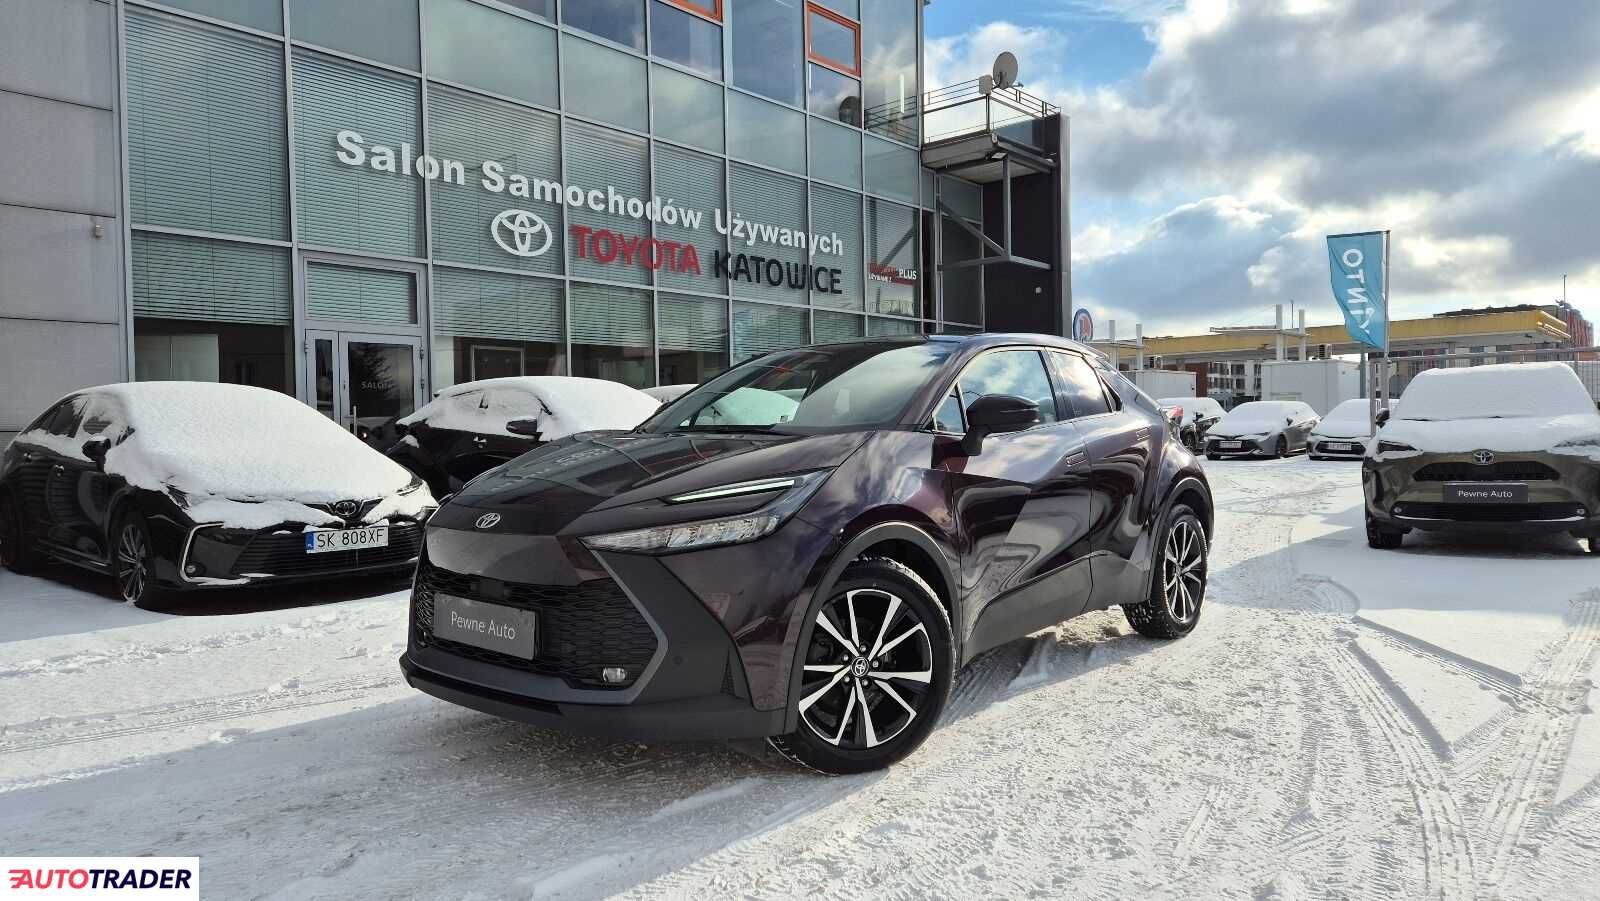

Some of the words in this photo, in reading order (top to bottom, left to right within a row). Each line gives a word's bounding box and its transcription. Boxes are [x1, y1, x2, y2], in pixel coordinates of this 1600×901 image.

[336, 130, 465, 186] Salon
[481, 160, 703, 229] Samochodów
[714, 208, 844, 256] Używanych
[571, 224, 702, 276] TOYOTA
[714, 250, 843, 294] KATOWICE
[899, 268, 917, 280] PLUS
[1458, 490, 1488, 498] Pewne
[1490, 490, 1513, 498] Auto
[317, 532, 336, 548] SK
[342, 528, 385, 546] 808XF
[451, 610, 485, 633] Pewne
[488, 619, 516, 640] Auto
